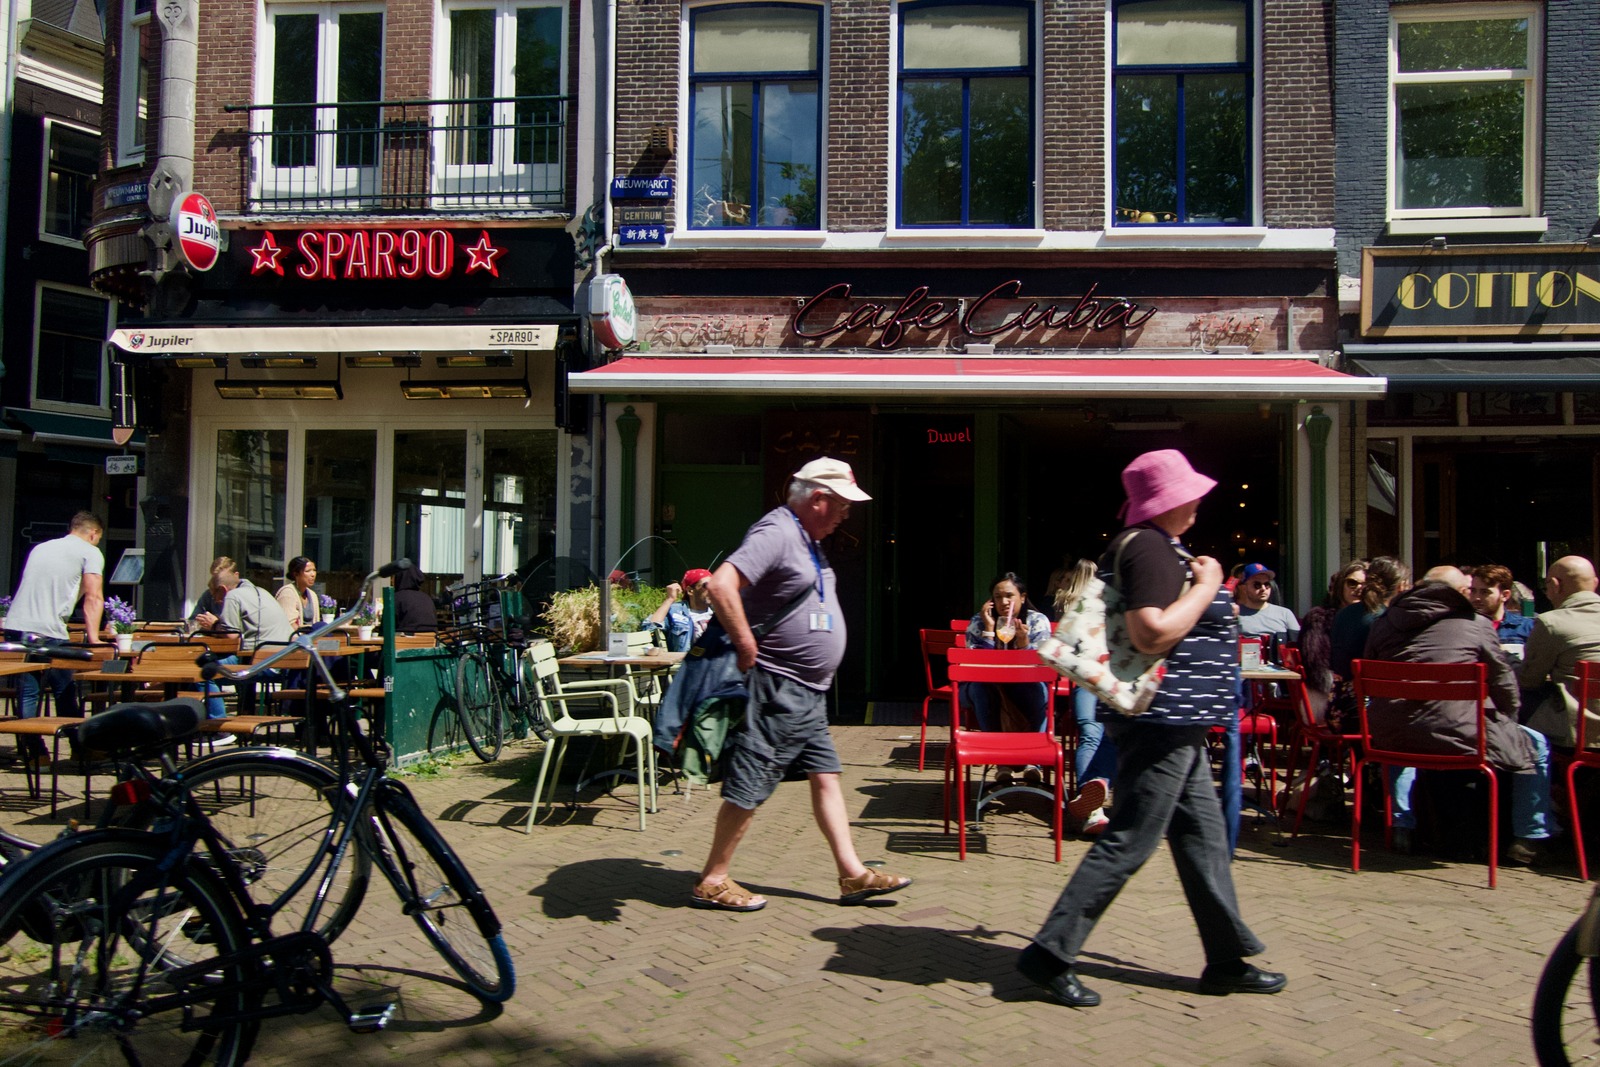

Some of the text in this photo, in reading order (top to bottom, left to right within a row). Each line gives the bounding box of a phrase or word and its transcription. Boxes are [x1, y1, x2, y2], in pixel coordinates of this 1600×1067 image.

[615, 179, 669, 189] NIEUWMARKT
[649, 189, 669, 197] Centrum
[624, 211, 662, 220] CENTRUM
[626, 228, 659, 240] 新廣場
[297, 229, 454, 280] SPAR90
[793, 279, 1158, 349] Cafe Cuba
[147, 335, 193, 347] Jupiler
[496, 331, 533, 343] SPAR90
[927, 427, 971, 444] Duvel
